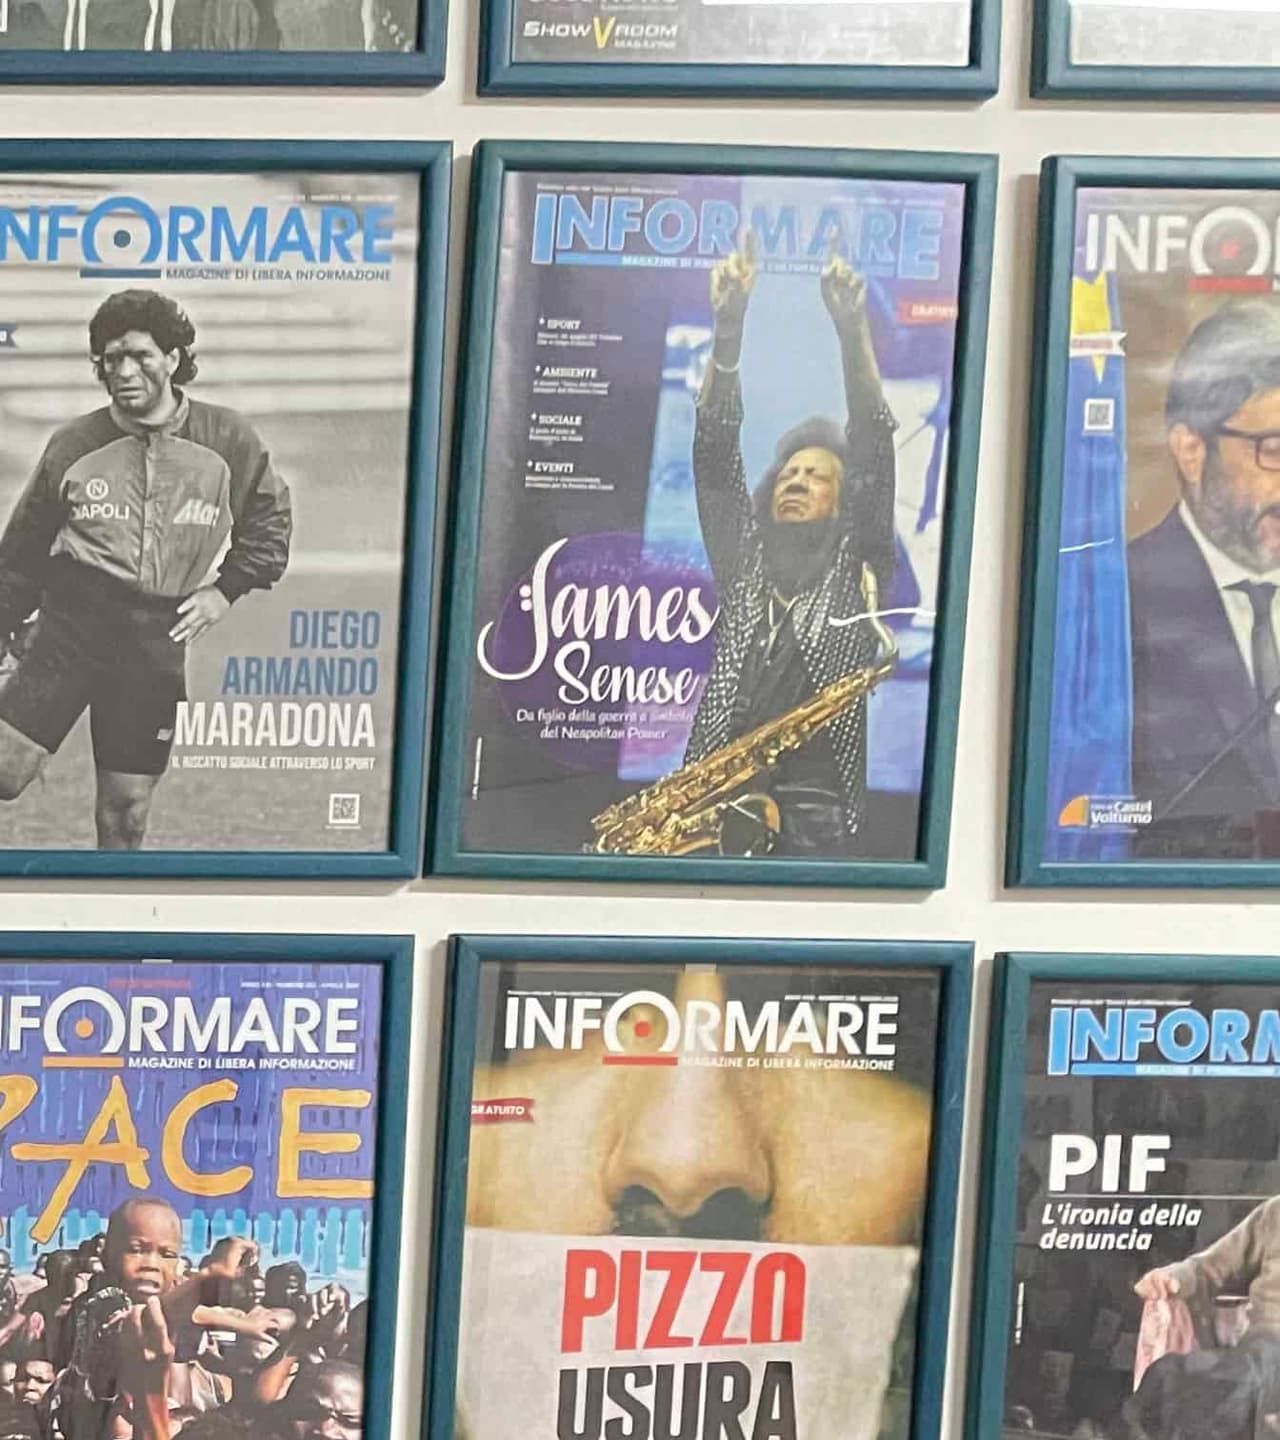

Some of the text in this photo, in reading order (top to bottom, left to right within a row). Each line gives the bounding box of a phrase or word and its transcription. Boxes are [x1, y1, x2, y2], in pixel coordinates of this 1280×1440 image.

[531, 193, 944, 280] INFORMARE
[166, 267, 391, 283] MAGAZINE DI LIBERA INFORMAZIONE
[542, 367, 598, 379] AMBIENTE
[538, 414, 583, 427] SOCIALE
[535, 462, 574, 474] EVENTI
[477, 537, 721, 681] James
[290, 610, 381, 650] DIEGO
[221, 656, 379, 697] ARMANDO
[554, 640, 700, 705] Senese
[175, 702, 376, 748] MARADONA
[517, 708, 597, 727] Da figlio della
[540, 726, 559, 739] del
[331, 757, 376, 770] LO SPORT
[504, 990, 899, 1056] INFORMARE
[128, 1057, 356, 1071] MAGAZINE DI LIBERA INFORMAZIONE
[746, 1058, 895, 1072] DI LIBERA INFORMAZIONE
[1048, 1134, 1171, 1193] PIF
[1041, 1203, 1201, 1227] L'ironia della
[1039, 1228, 1152, 1251] denuncia
[560, 1248, 807, 1353] PIZZO
